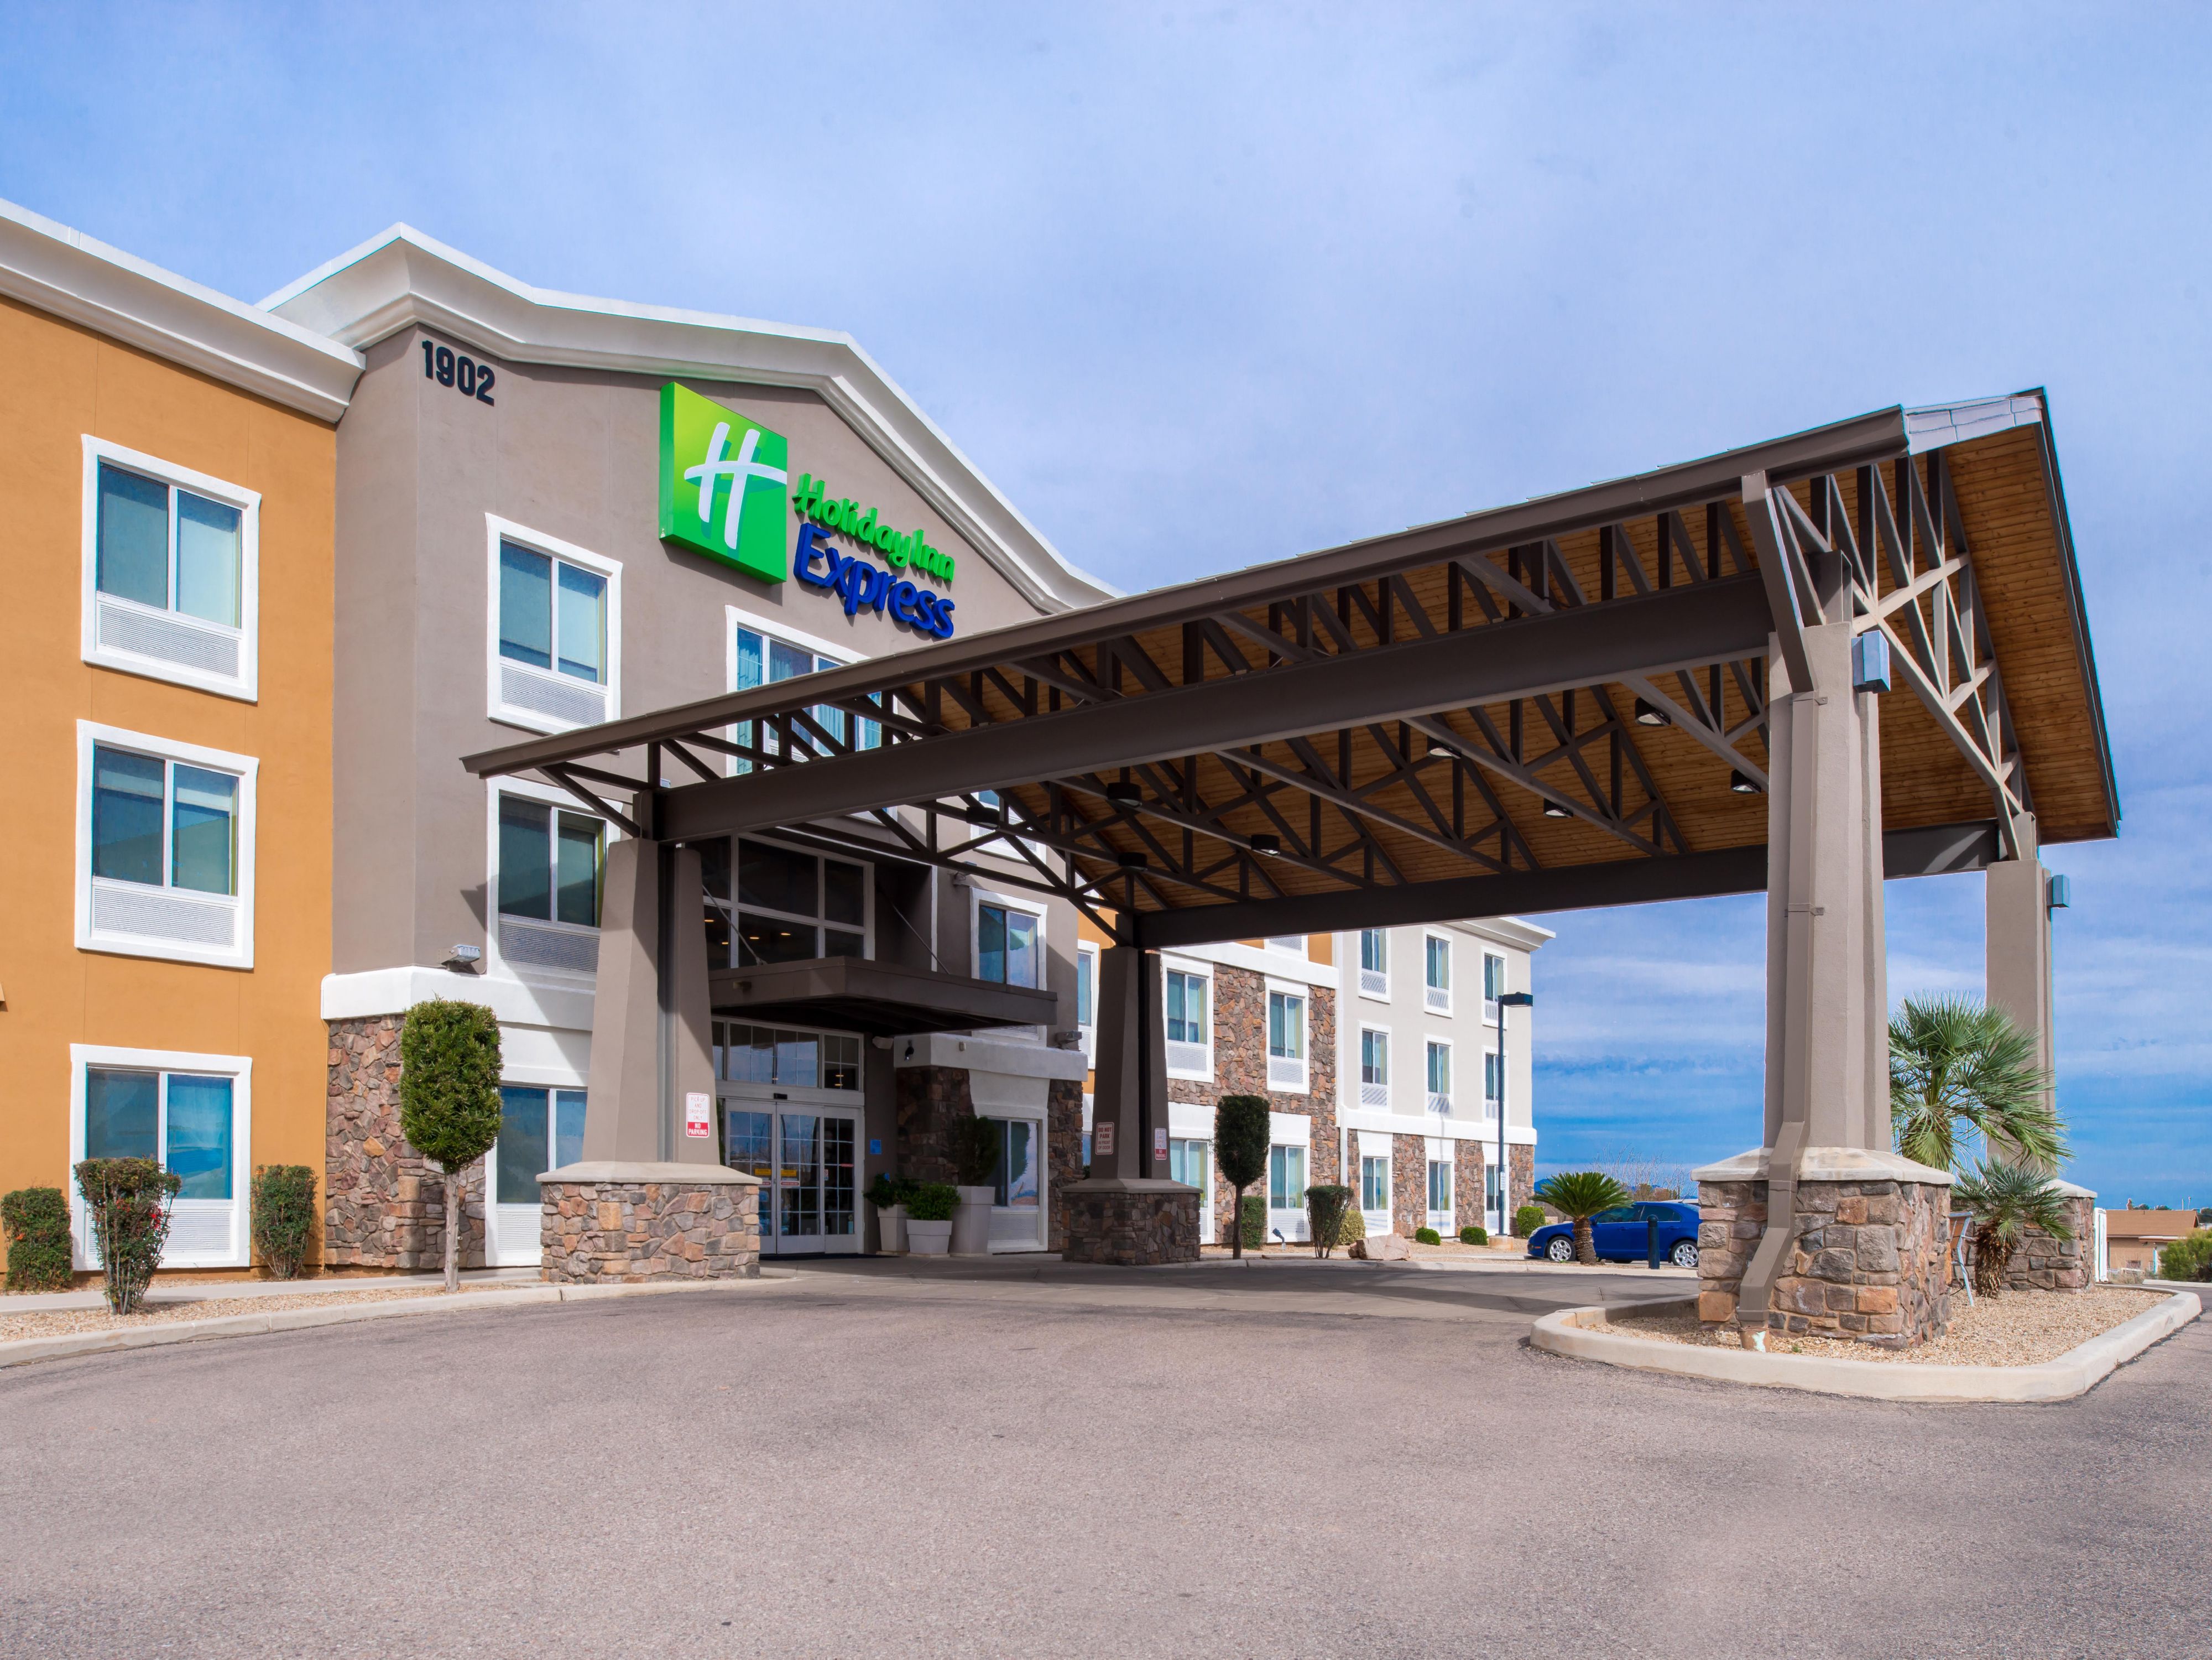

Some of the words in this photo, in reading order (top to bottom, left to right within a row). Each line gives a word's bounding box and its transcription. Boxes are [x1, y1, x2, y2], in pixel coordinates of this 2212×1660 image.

[422, 340, 495, 407] 1902
[792, 473, 912, 568] Holiday
[910, 529, 955, 582] Inn
[793, 522, 956, 638] Express
